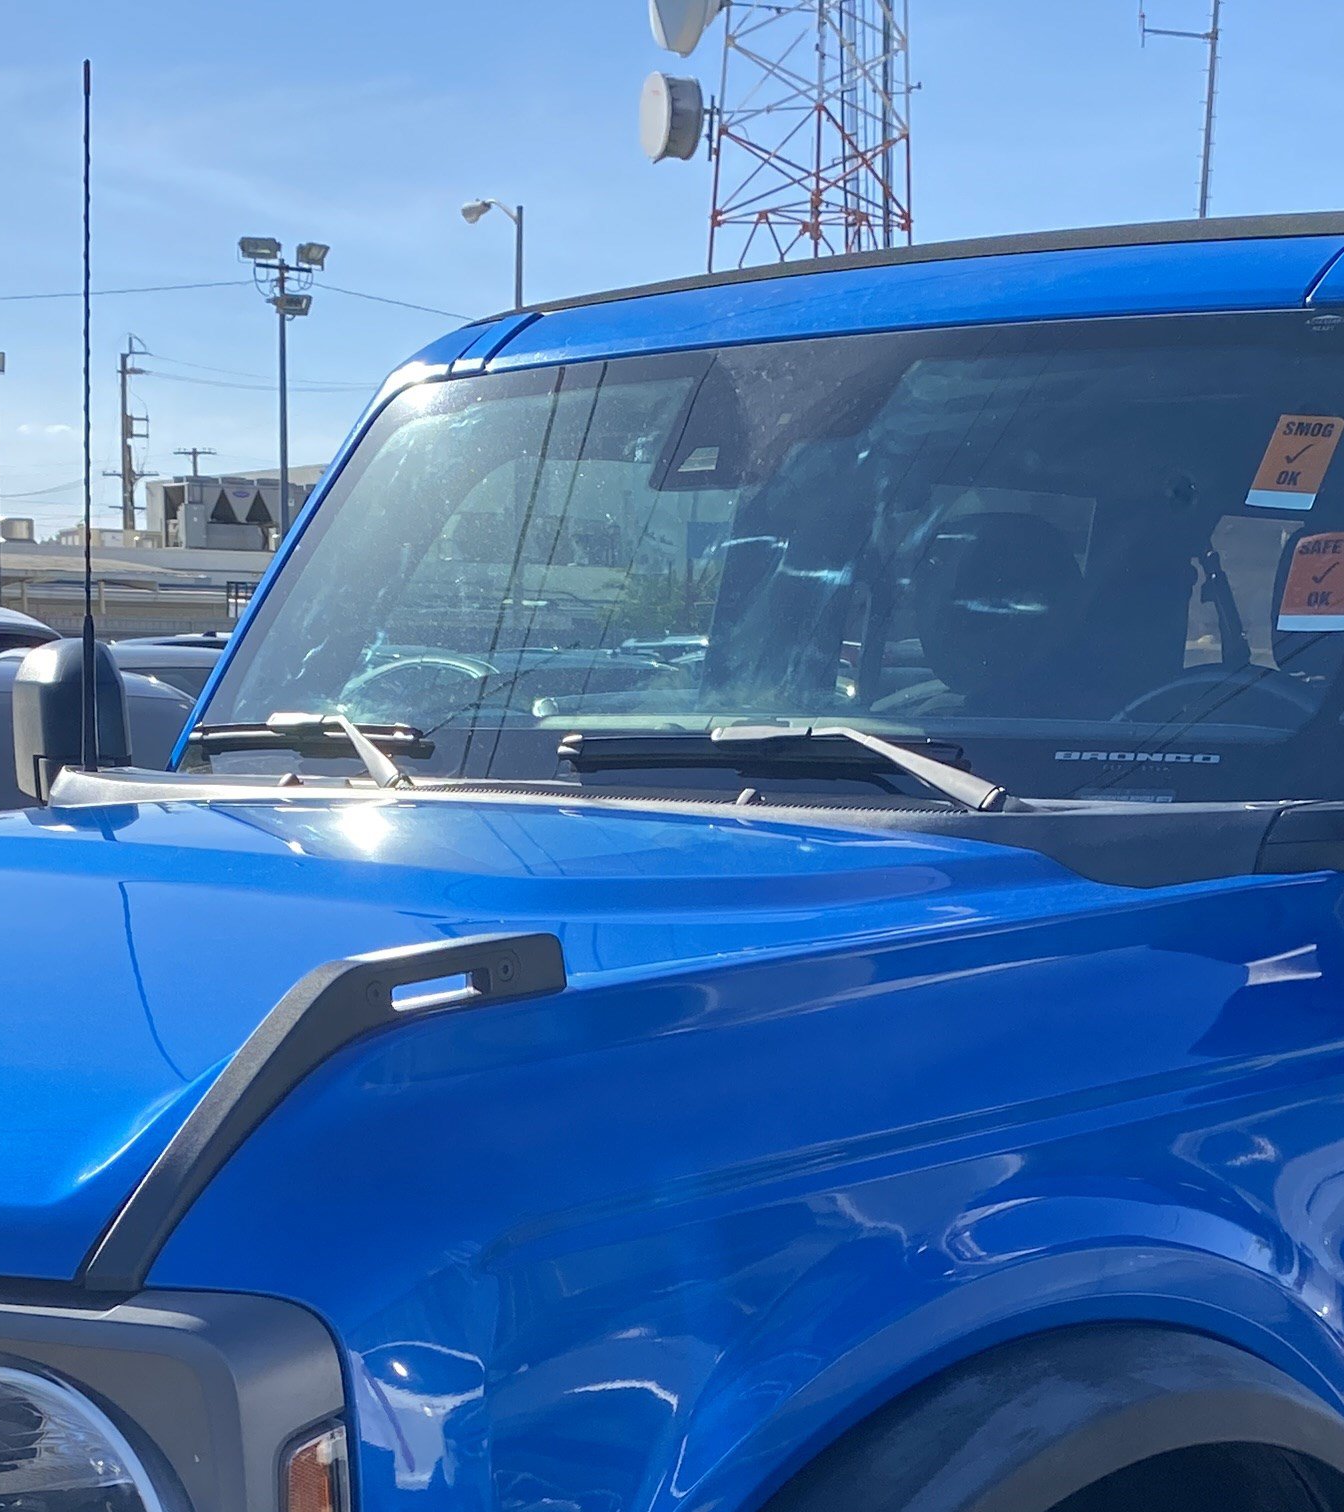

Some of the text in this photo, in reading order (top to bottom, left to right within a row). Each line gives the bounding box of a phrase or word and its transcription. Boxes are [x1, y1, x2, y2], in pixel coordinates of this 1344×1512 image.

[1282, 421, 1335, 438] SMOG
[1275, 470, 1302, 486] OK
[1306, 590, 1332, 608] OK
[1054, 751, 1221, 764] BRONCO
